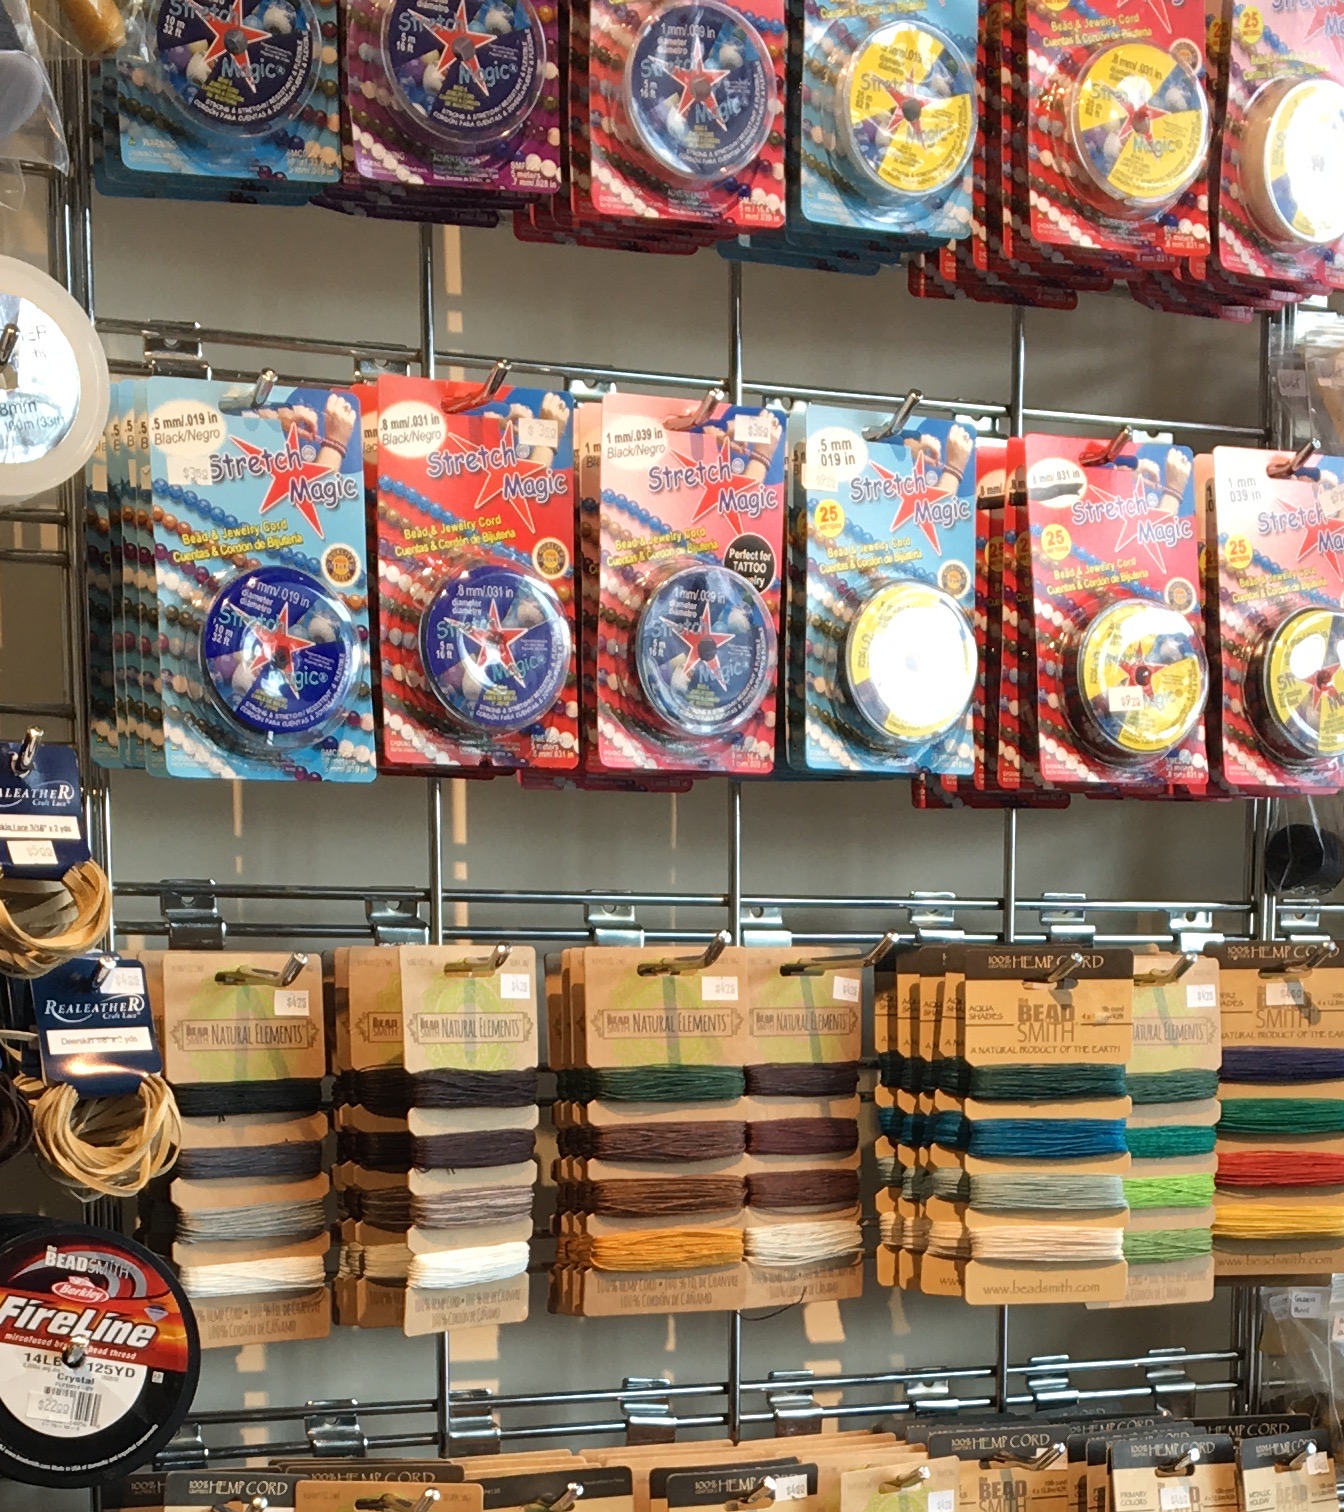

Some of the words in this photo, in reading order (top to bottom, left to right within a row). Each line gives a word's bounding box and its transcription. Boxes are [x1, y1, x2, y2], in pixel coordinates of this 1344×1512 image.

[208, 411, 218, 424] in
[154, 429, 221, 446] Black/Negro
[382, 430, 442, 447] Black/Negro
[210, 443, 303, 481] Stretch
[427, 440, 517, 478] Stretch
[648, 455, 733, 493] Stretch
[289, 473, 359, 508] Magic
[502, 469, 567, 503] Magic
[850, 471, 927, 502] Stretch
[717, 485, 777, 517] Magic
[819, 505, 839, 522] 25
[913, 495, 971, 527] Magic
[404, 527, 428, 541] Bead
[430, 525, 437, 537] &
[440, 518, 476, 535] Jewelry
[478, 514, 502, 528] Cord
[430, 540, 437, 551] &
[471, 532, 481, 545] de
[728, 548, 757, 562] Perfect
[759, 550, 772, 562] for
[733, 562, 767, 574] TATTOO
[1017, 1003, 1074, 1023] BEAD
[1017, 1022, 1074, 1043] SMITH
[1059, 1045, 1071, 1054] OF
[1072, 1045, 1089, 1054] THE
[1091, 1044, 1120, 1053] EARTH
[45, 1250, 130, 1280] BEADSMITH
[60, 1282, 102, 1300] Berkley
[983, 1281, 1101, 1298] www.beadsmith.com
[109, 1350, 137, 1361] thread
[87, 1361, 136, 1378] 125YD
[57, 1373, 95, 1385] Crystal
[209, 1480, 245, 1496] HEMP
[246, 1480, 288, 1496] CORD
